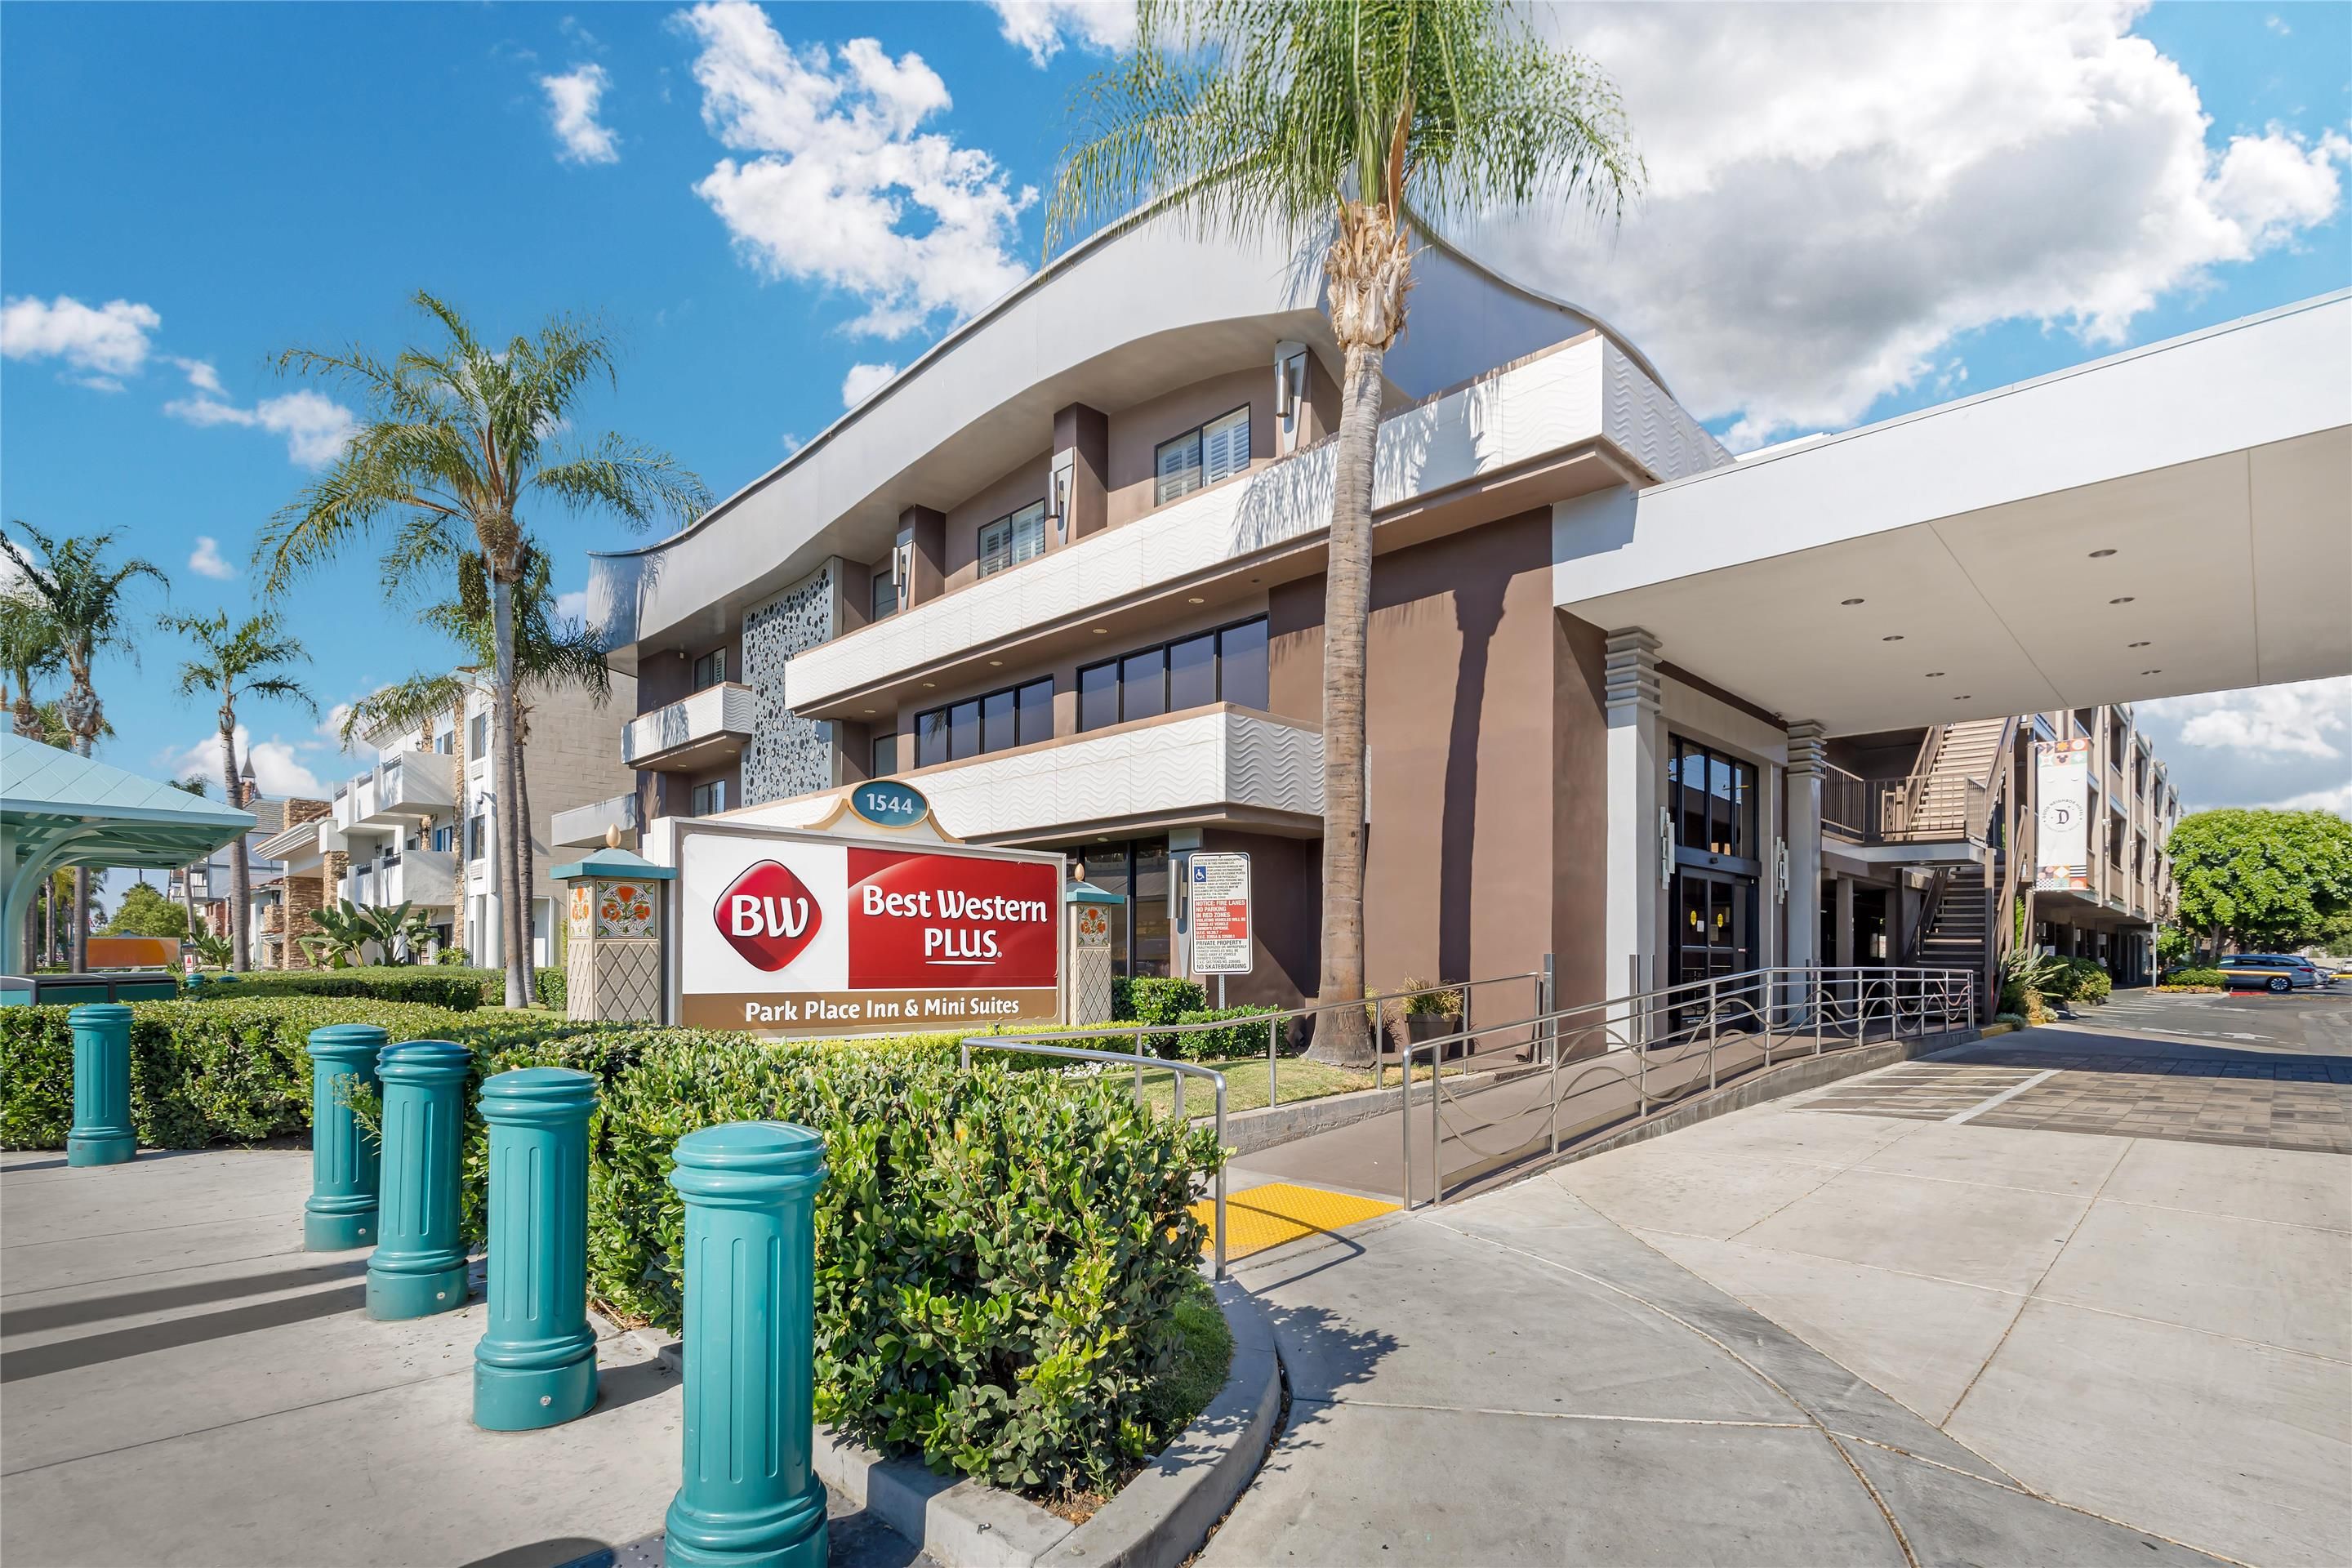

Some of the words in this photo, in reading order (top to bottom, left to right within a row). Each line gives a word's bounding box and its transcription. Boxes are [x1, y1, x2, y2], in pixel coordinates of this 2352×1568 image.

[866, 793, 913, 814] 1544
[2054, 808, 2069, 825] D
[732, 894, 808, 938] BW
[862, 884, 932, 918] Best
[937, 889, 1048, 923] Western
[746, 1000, 798, 1022] Park
[804, 1000, 860, 1020] Place
[866, 1000, 899, 1018] Inn
[904, 999, 919, 1017] &
[924, 997, 964, 1016] Mini
[970, 996, 1019, 1014] Suites
